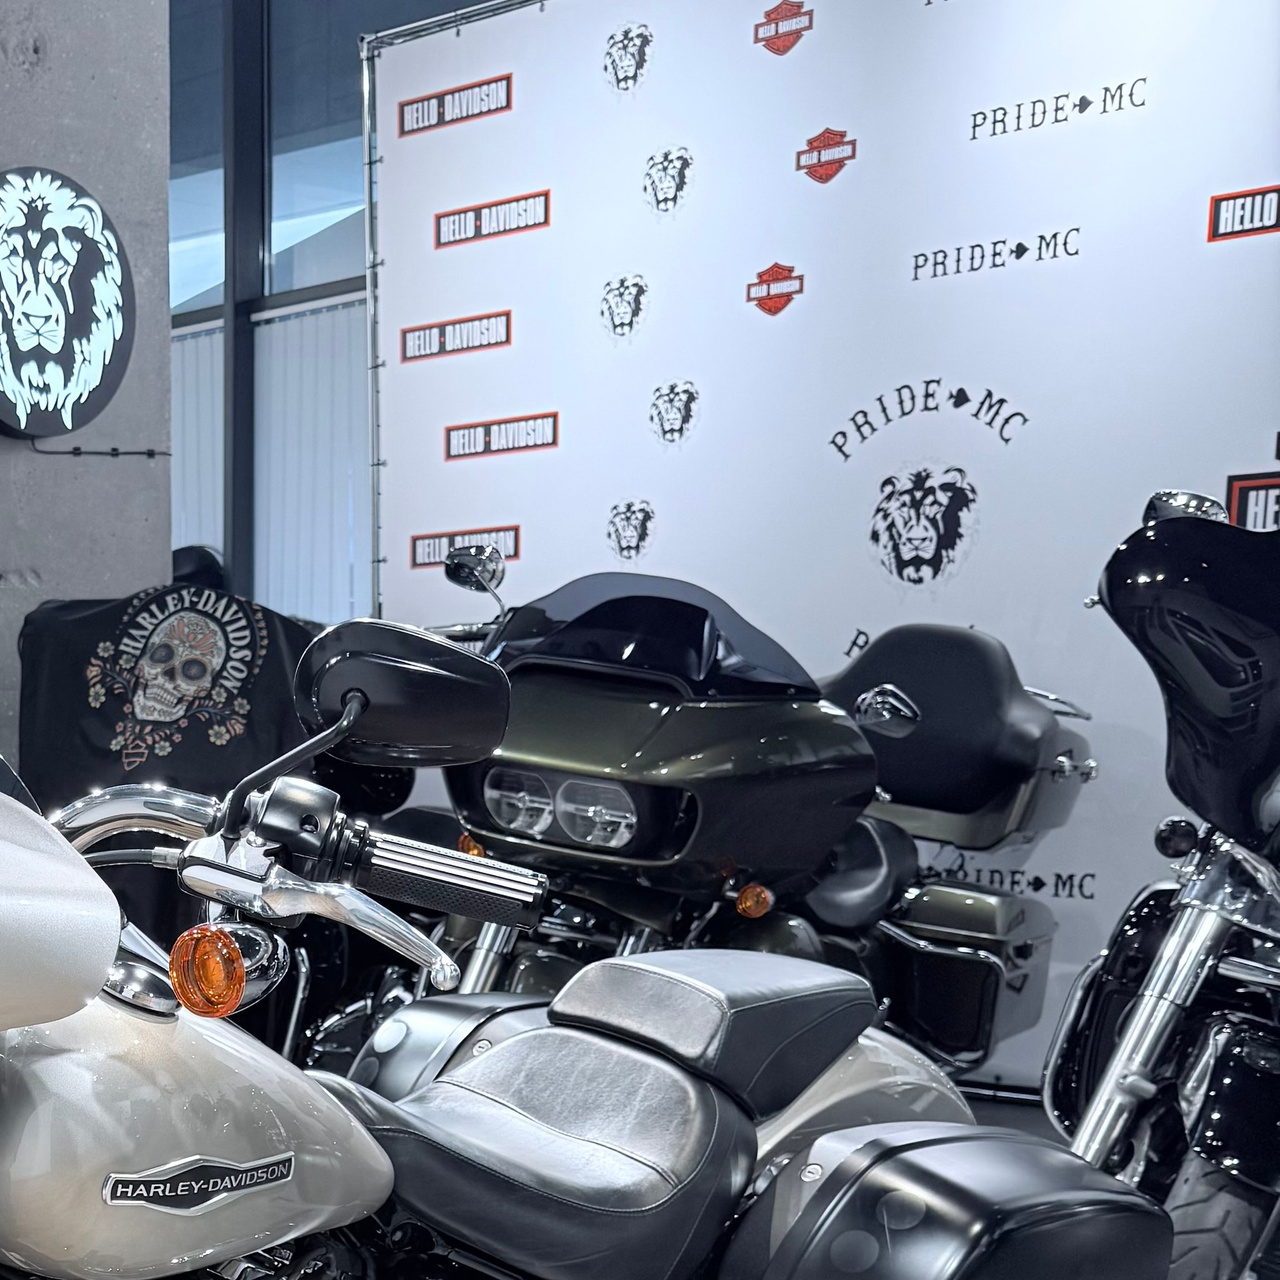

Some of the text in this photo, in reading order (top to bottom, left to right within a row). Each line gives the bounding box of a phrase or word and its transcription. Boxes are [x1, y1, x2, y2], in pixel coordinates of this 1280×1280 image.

[403, 79, 508, 132] HELLO DAVIDSON
[970, 77, 1148, 140] PRIDE MC
[439, 195, 546, 244] HELLO DAVIDSON
[1218, 192, 1278, 234] HELLO
[912, 227, 1081, 281] PRIDE MC
[405, 315, 507, 358] HELLO DAVIDSON
[449, 416, 554, 456] HELLO DAVIDSON
[828, 377, 1029, 462] PRIDE MC
[119, 588, 252, 694] HARLEY-DAVIDSON
[1052, 872, 1096, 899] MC
[116, 1163, 289, 1197] HARLEY-DAVIDSON
